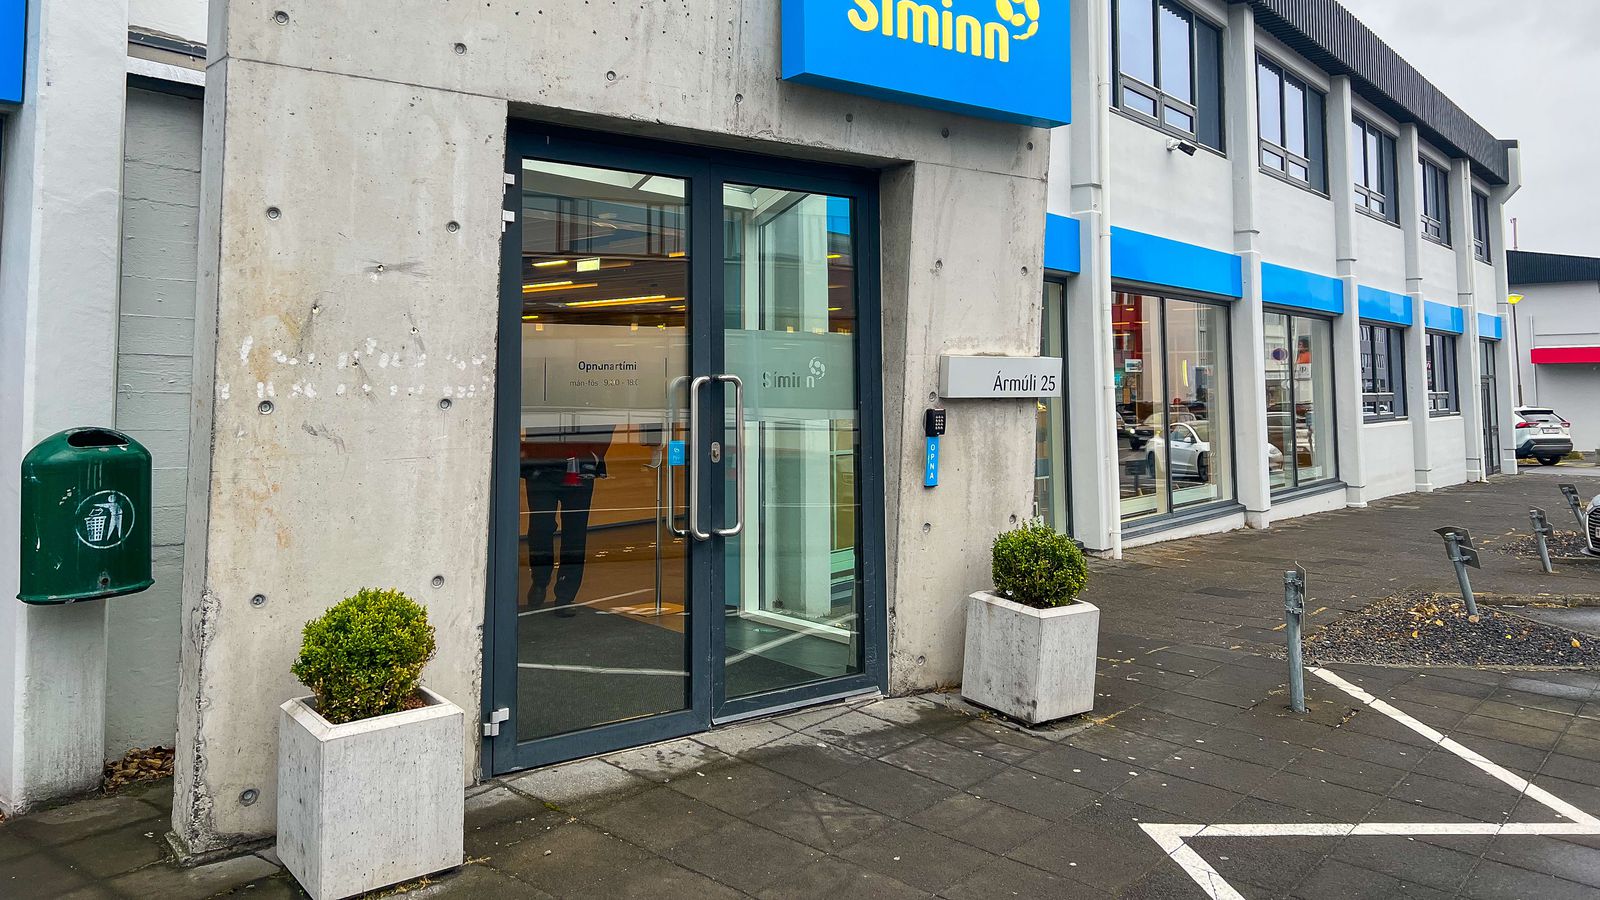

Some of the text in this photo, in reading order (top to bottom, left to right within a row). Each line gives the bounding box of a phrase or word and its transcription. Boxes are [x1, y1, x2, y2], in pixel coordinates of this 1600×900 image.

[578, 361, 637, 372] Opnunartími
[993, 370, 1056, 391] Ármúli 25
